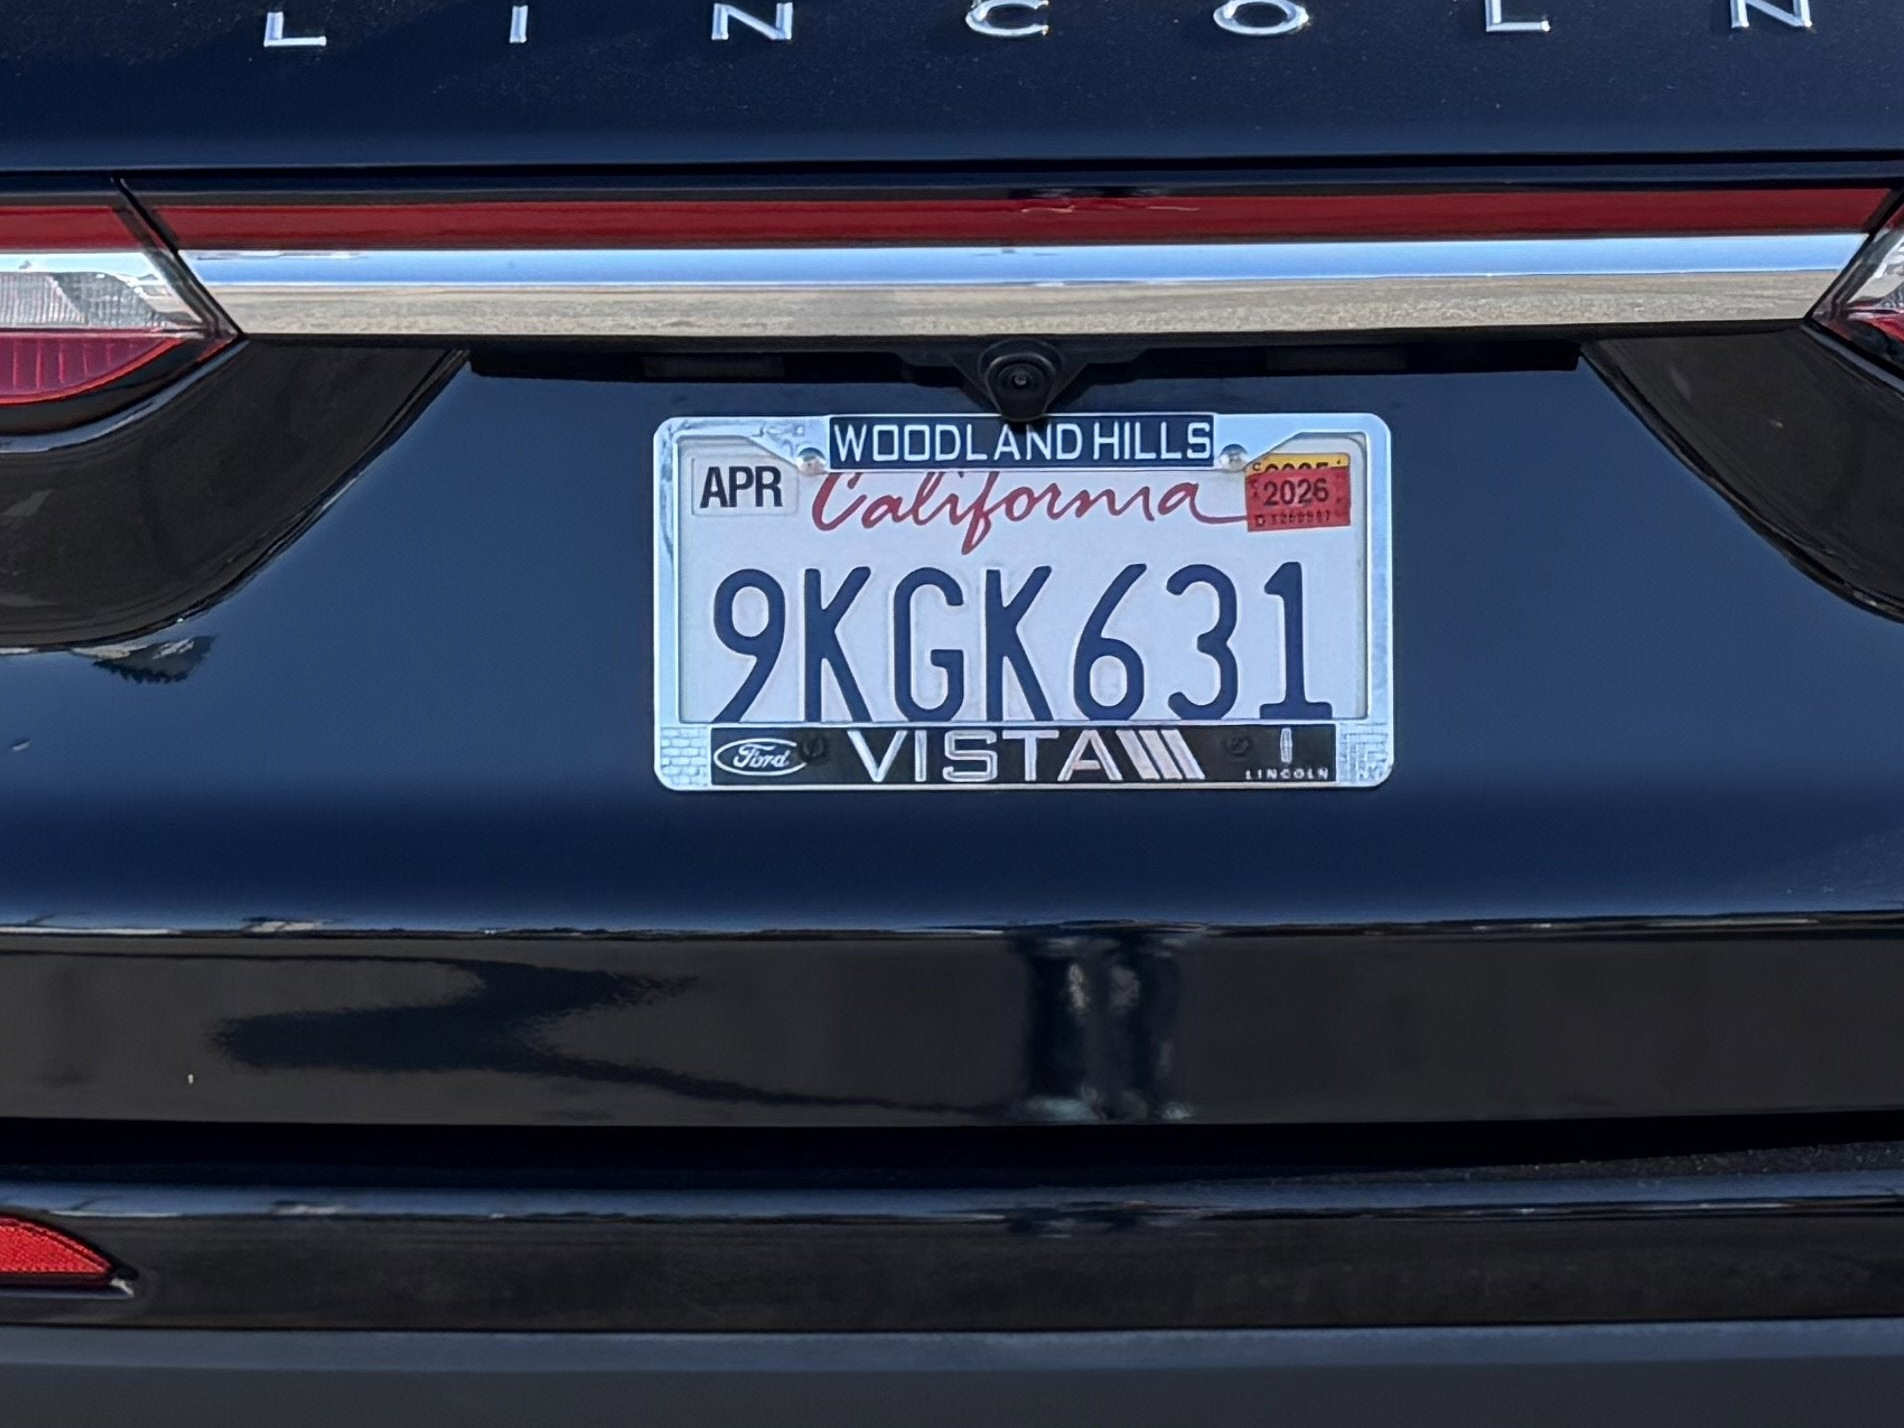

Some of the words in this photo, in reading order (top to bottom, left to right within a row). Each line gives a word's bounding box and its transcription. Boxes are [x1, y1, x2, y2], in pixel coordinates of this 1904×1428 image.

[834, 423, 1082, 461] WOODLAND
[1093, 421, 1211, 460] HILLS
[699, 465, 783, 509] APR
[1263, 477, 1329, 507] 2026
[811, 470, 1248, 555] California
[712, 561, 1333, 722] 9KGK631
[732, 743, 790, 768] Ford
[847, 729, 1124, 783] VISTA
[1246, 767, 1329, 781] LINCOLN
